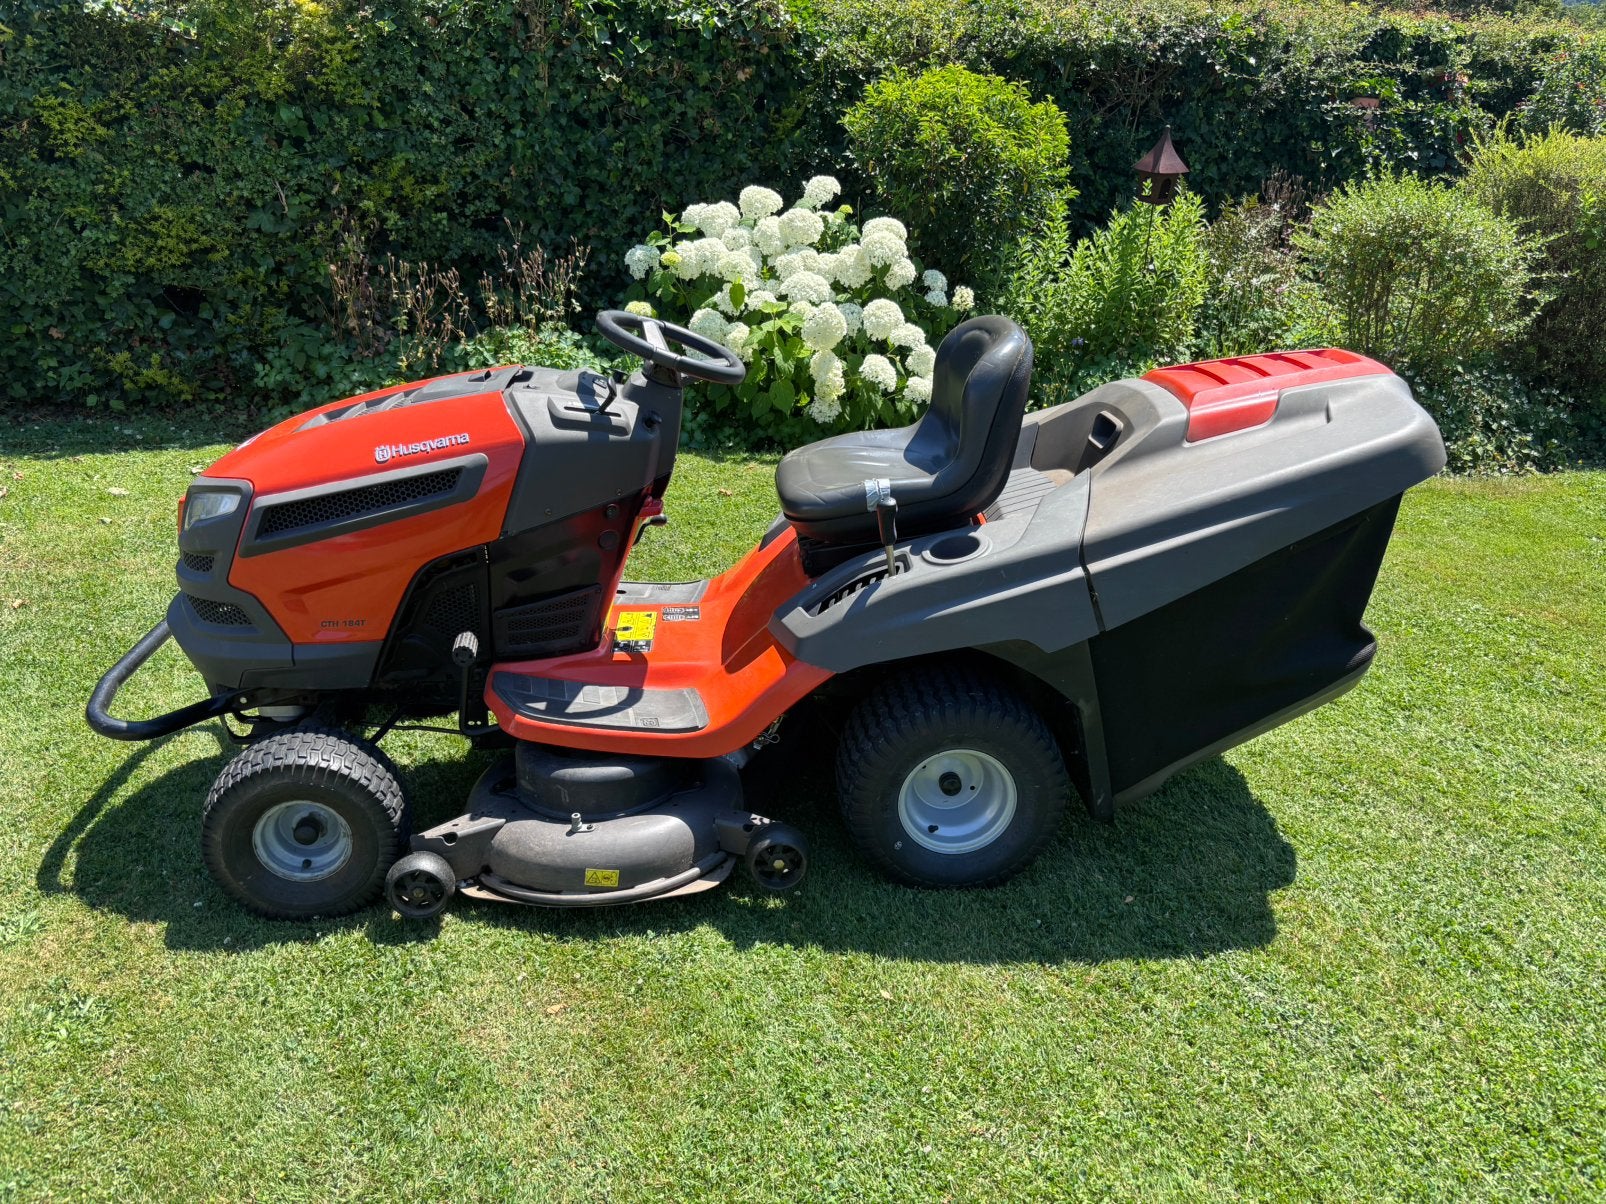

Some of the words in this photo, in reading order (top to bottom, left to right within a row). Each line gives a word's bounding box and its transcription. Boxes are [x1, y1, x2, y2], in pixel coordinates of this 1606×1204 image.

[391, 432, 470, 458] Husqvarna
[320, 620, 339, 628] CTH
[342, 619, 366, 627] 184T
